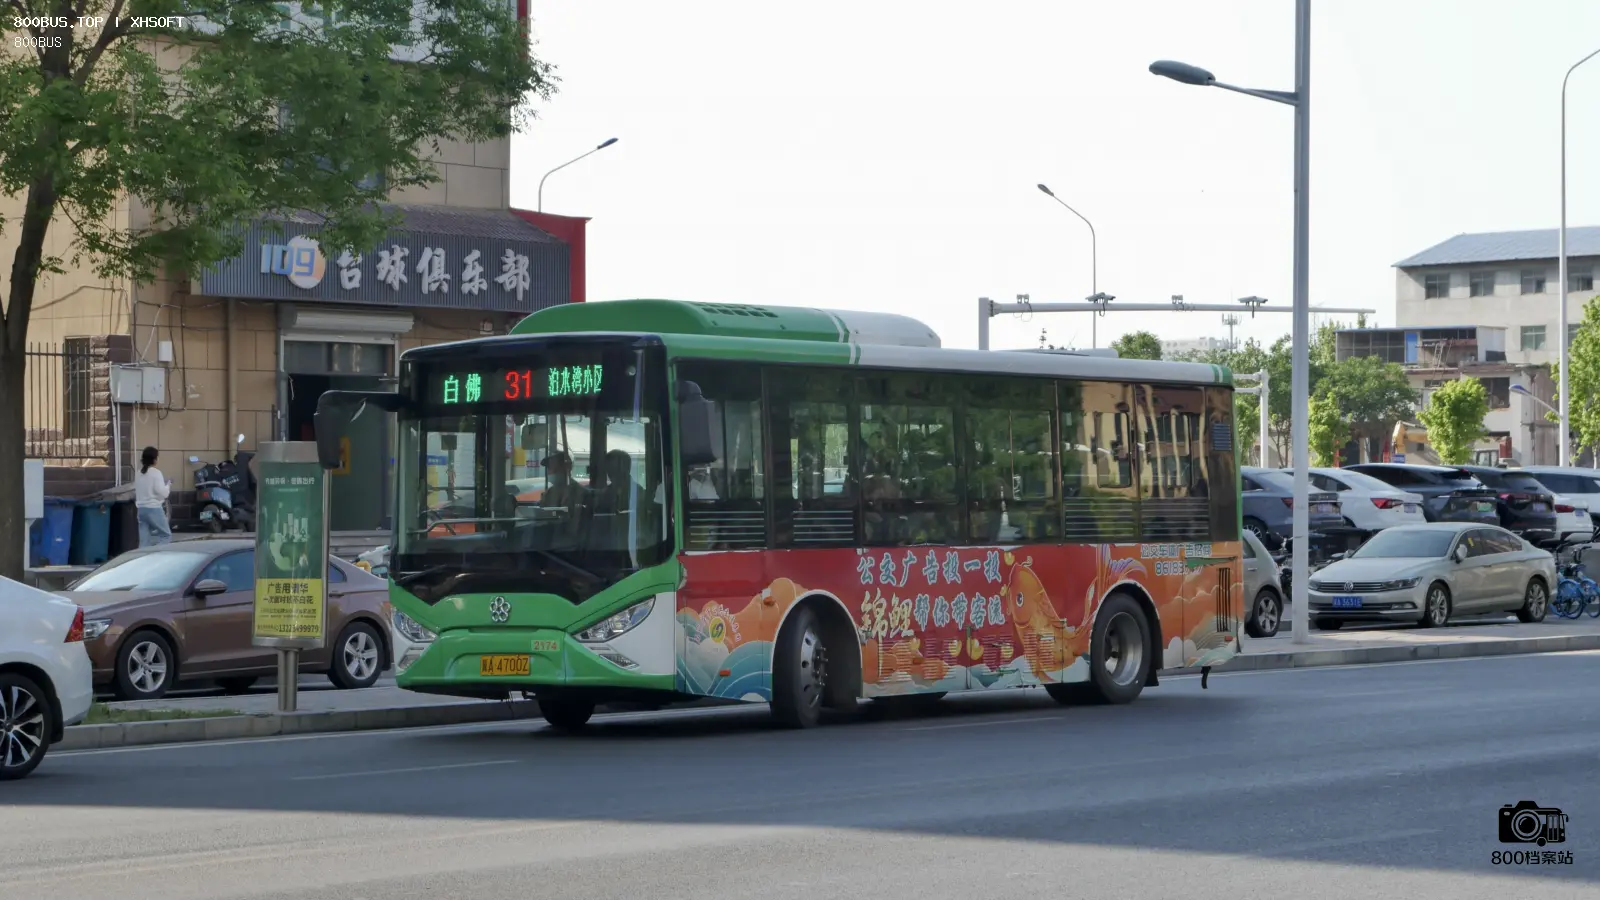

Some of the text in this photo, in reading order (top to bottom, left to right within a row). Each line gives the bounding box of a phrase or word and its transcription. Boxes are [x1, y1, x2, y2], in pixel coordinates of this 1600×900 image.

[336, 244, 531, 301] 台球俱乐部
[443, 373, 482, 404] 白佛
[504, 370, 532, 400] 31
[856, 549, 1002, 587] 公交广告投一投
